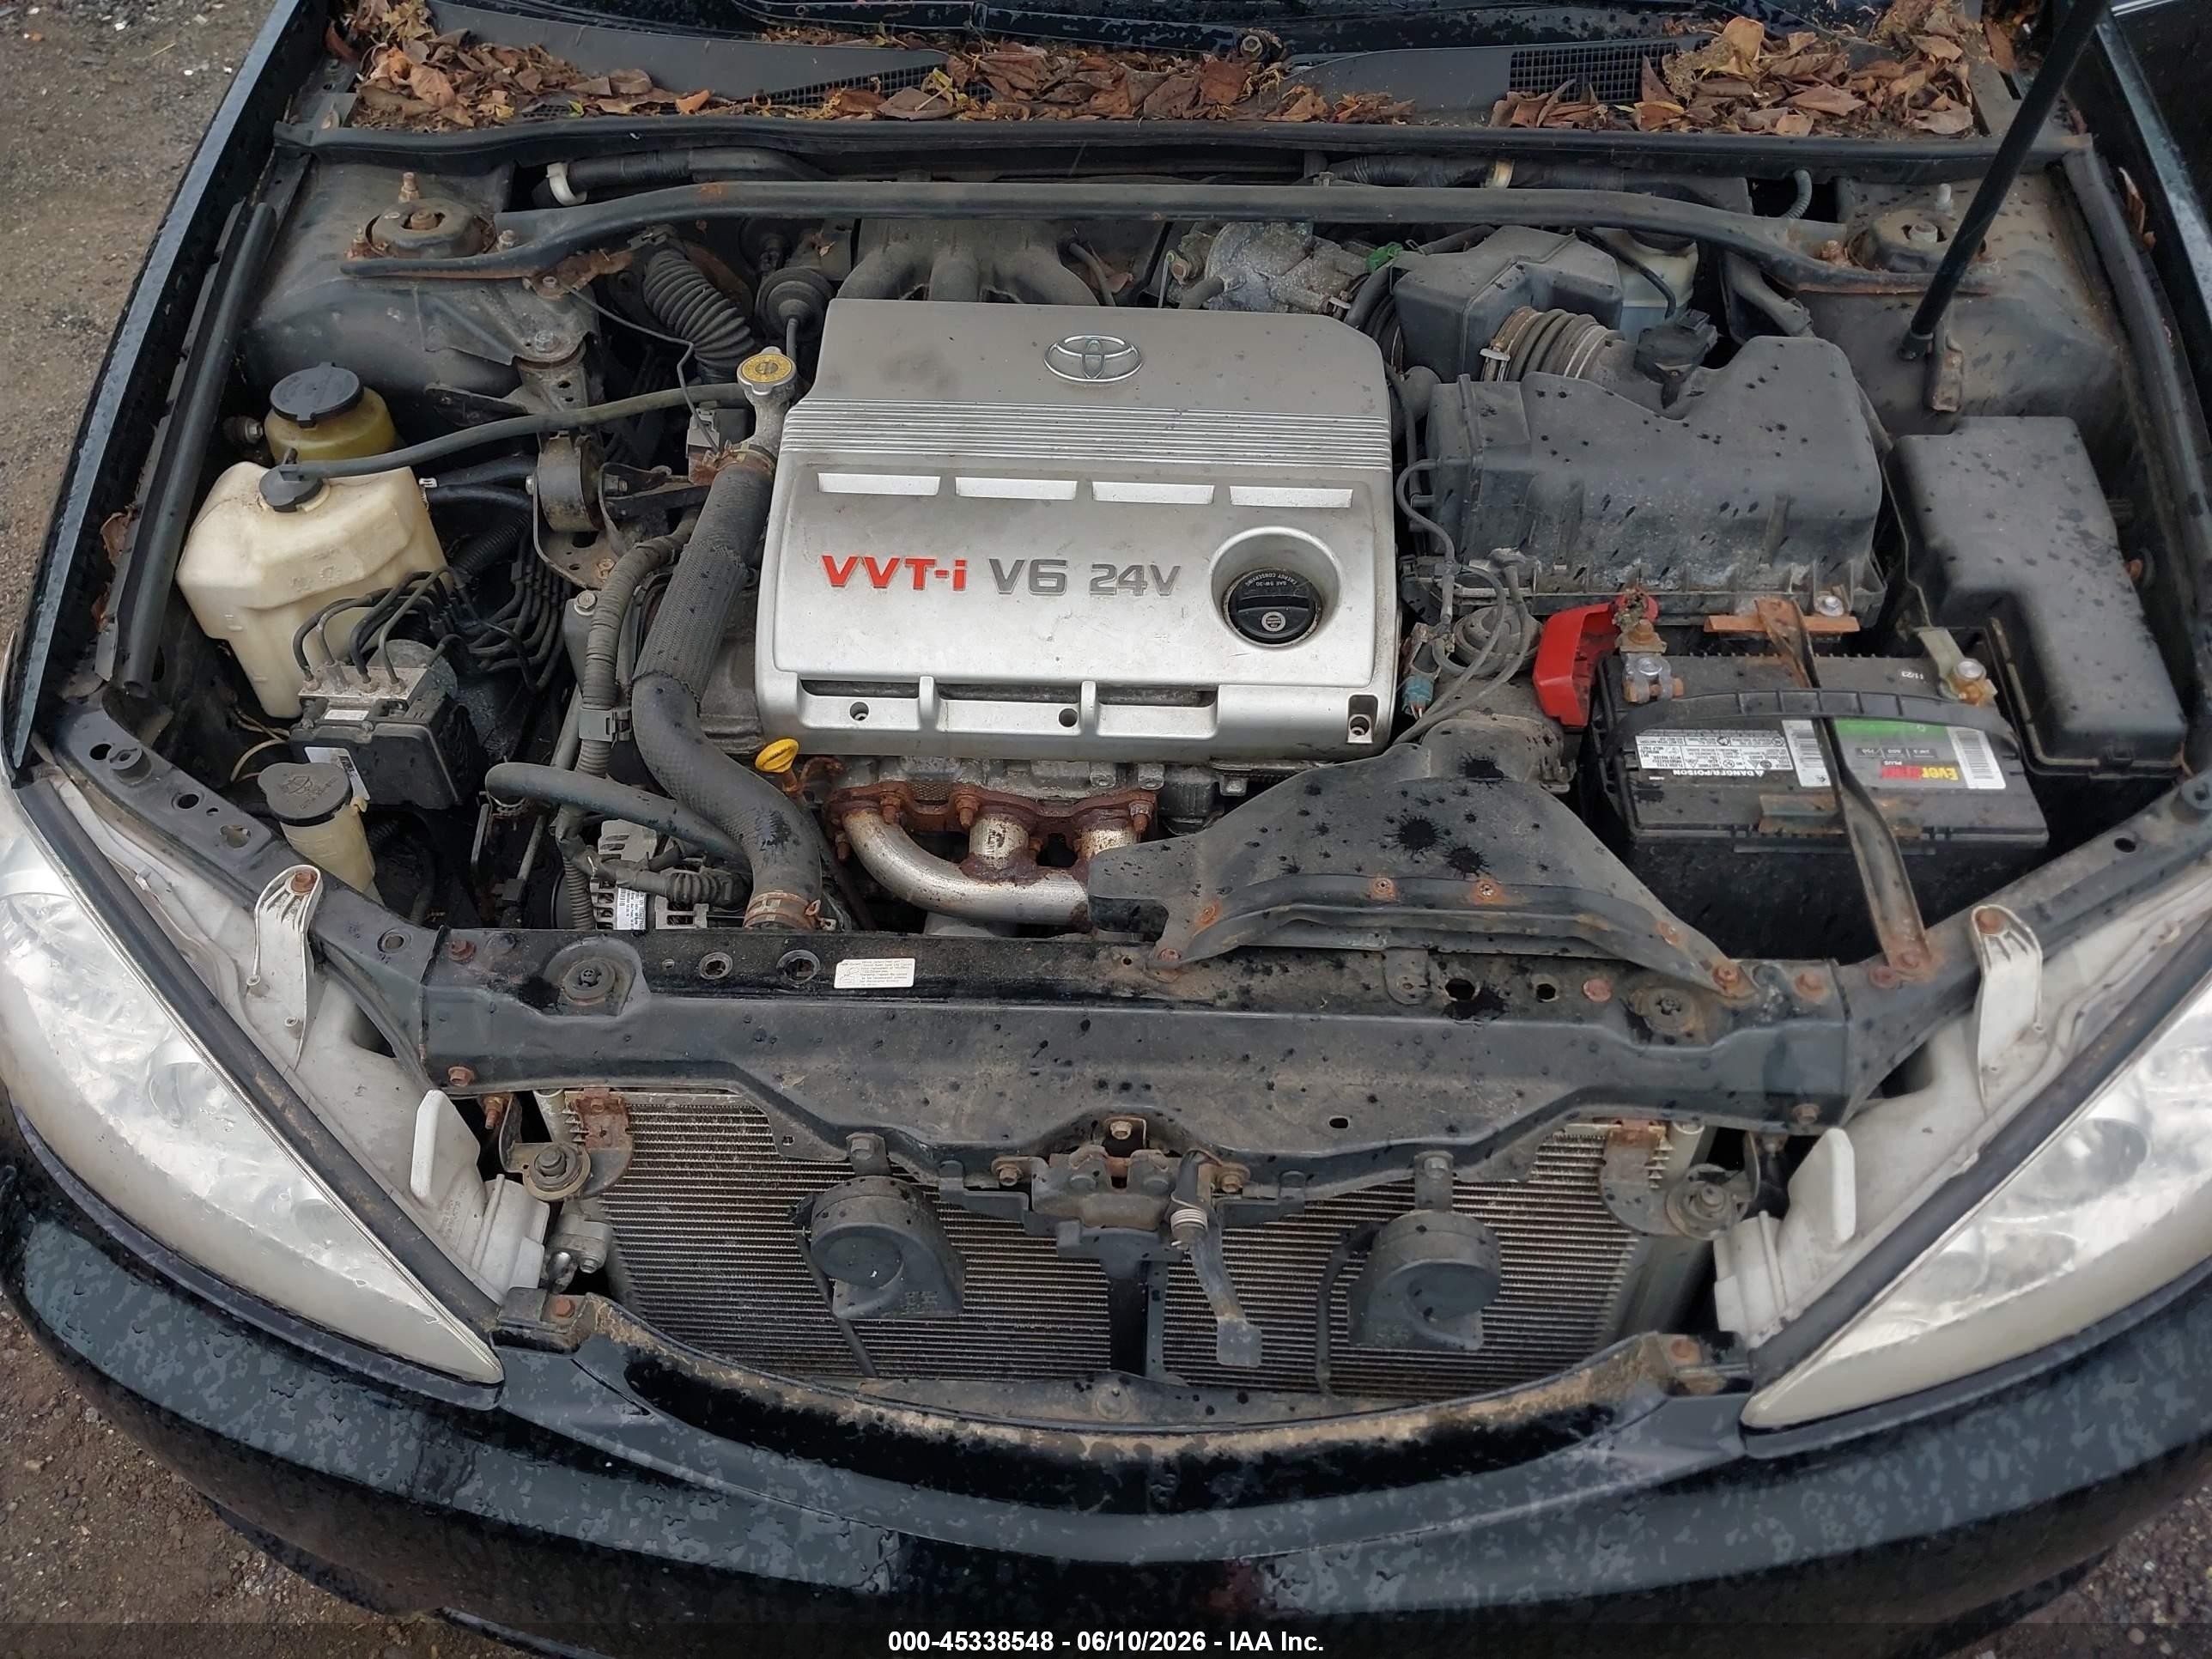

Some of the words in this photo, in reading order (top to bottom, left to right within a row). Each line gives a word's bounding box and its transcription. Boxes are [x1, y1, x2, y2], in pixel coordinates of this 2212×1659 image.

[821, 555, 967, 592] VVT-i
[988, 557, 1068, 596] V6
[1089, 563, 1182, 598] 24V
